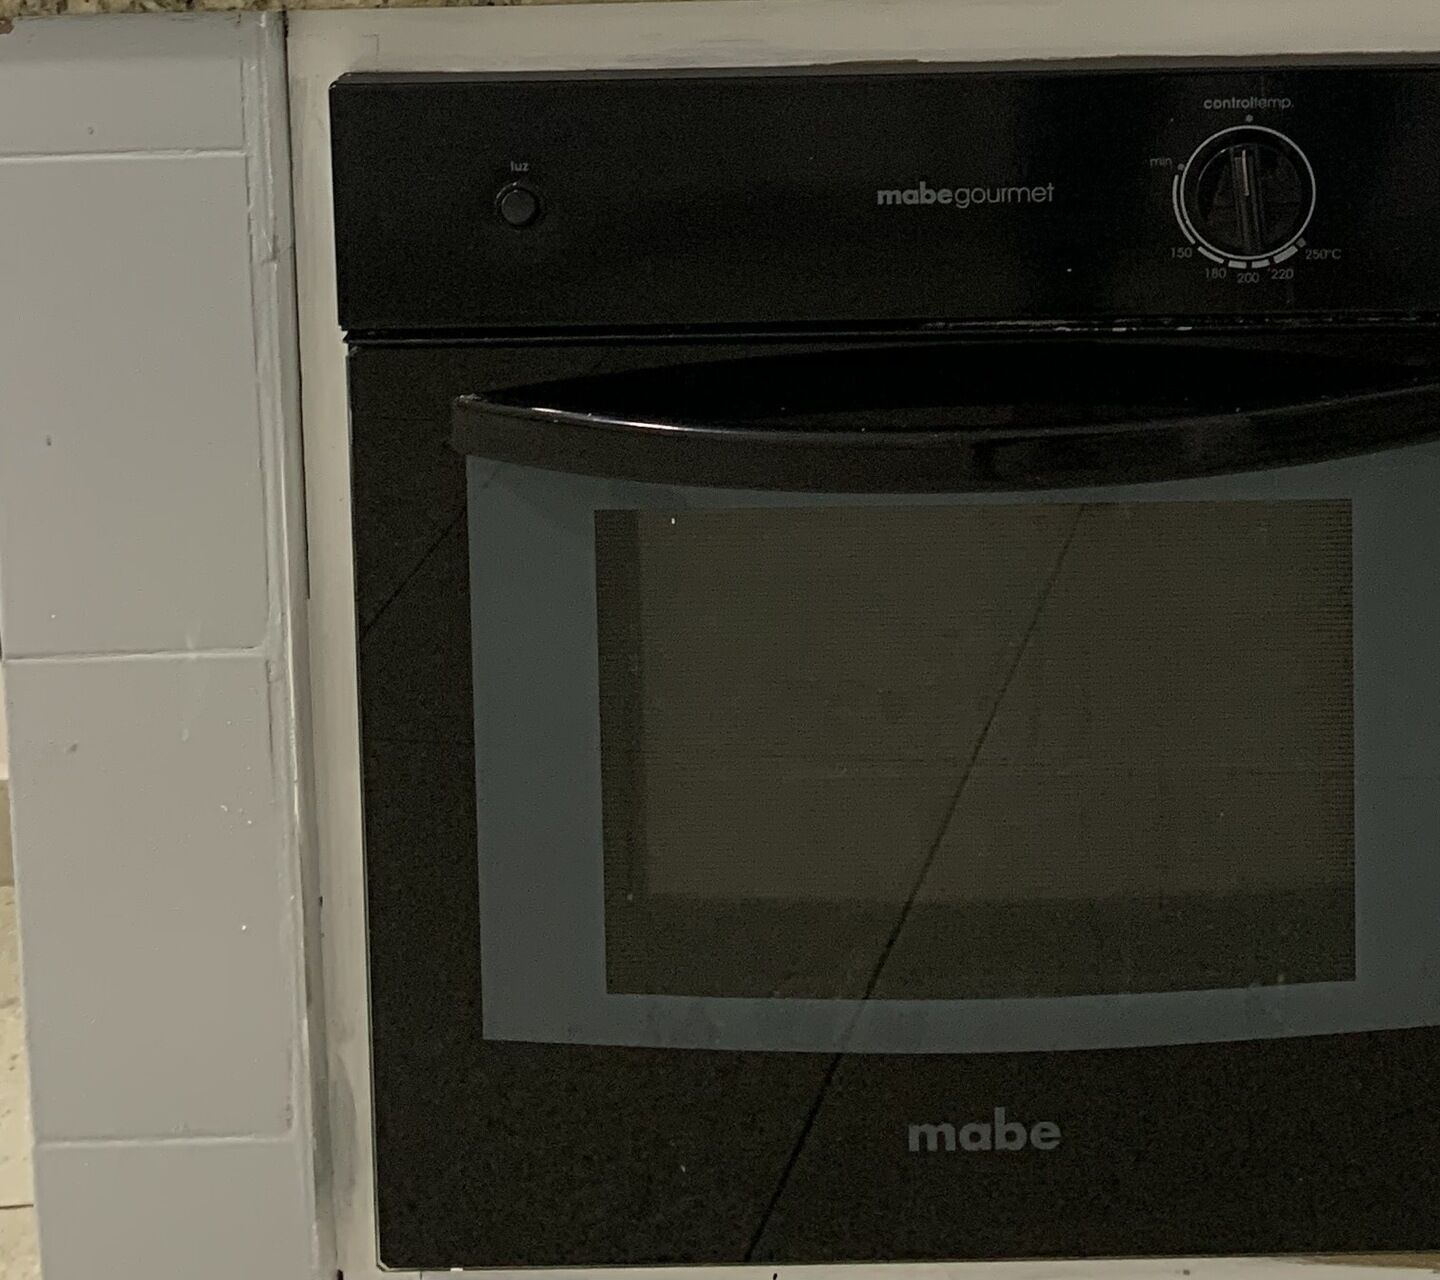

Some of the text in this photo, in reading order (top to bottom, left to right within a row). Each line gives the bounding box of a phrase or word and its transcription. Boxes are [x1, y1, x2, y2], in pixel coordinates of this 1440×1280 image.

[510, 160, 529, 172] luz
[1149, 156, 1173, 167] min
[1170, 247, 1193, 259] 150
[1305, 248, 1342, 260] 250°C
[1205, 267, 1227, 280] 180
[1236, 272, 1260, 284] 200
[1270, 268, 1295, 280] 220
[908, 1107, 1062, 1152] mabe
